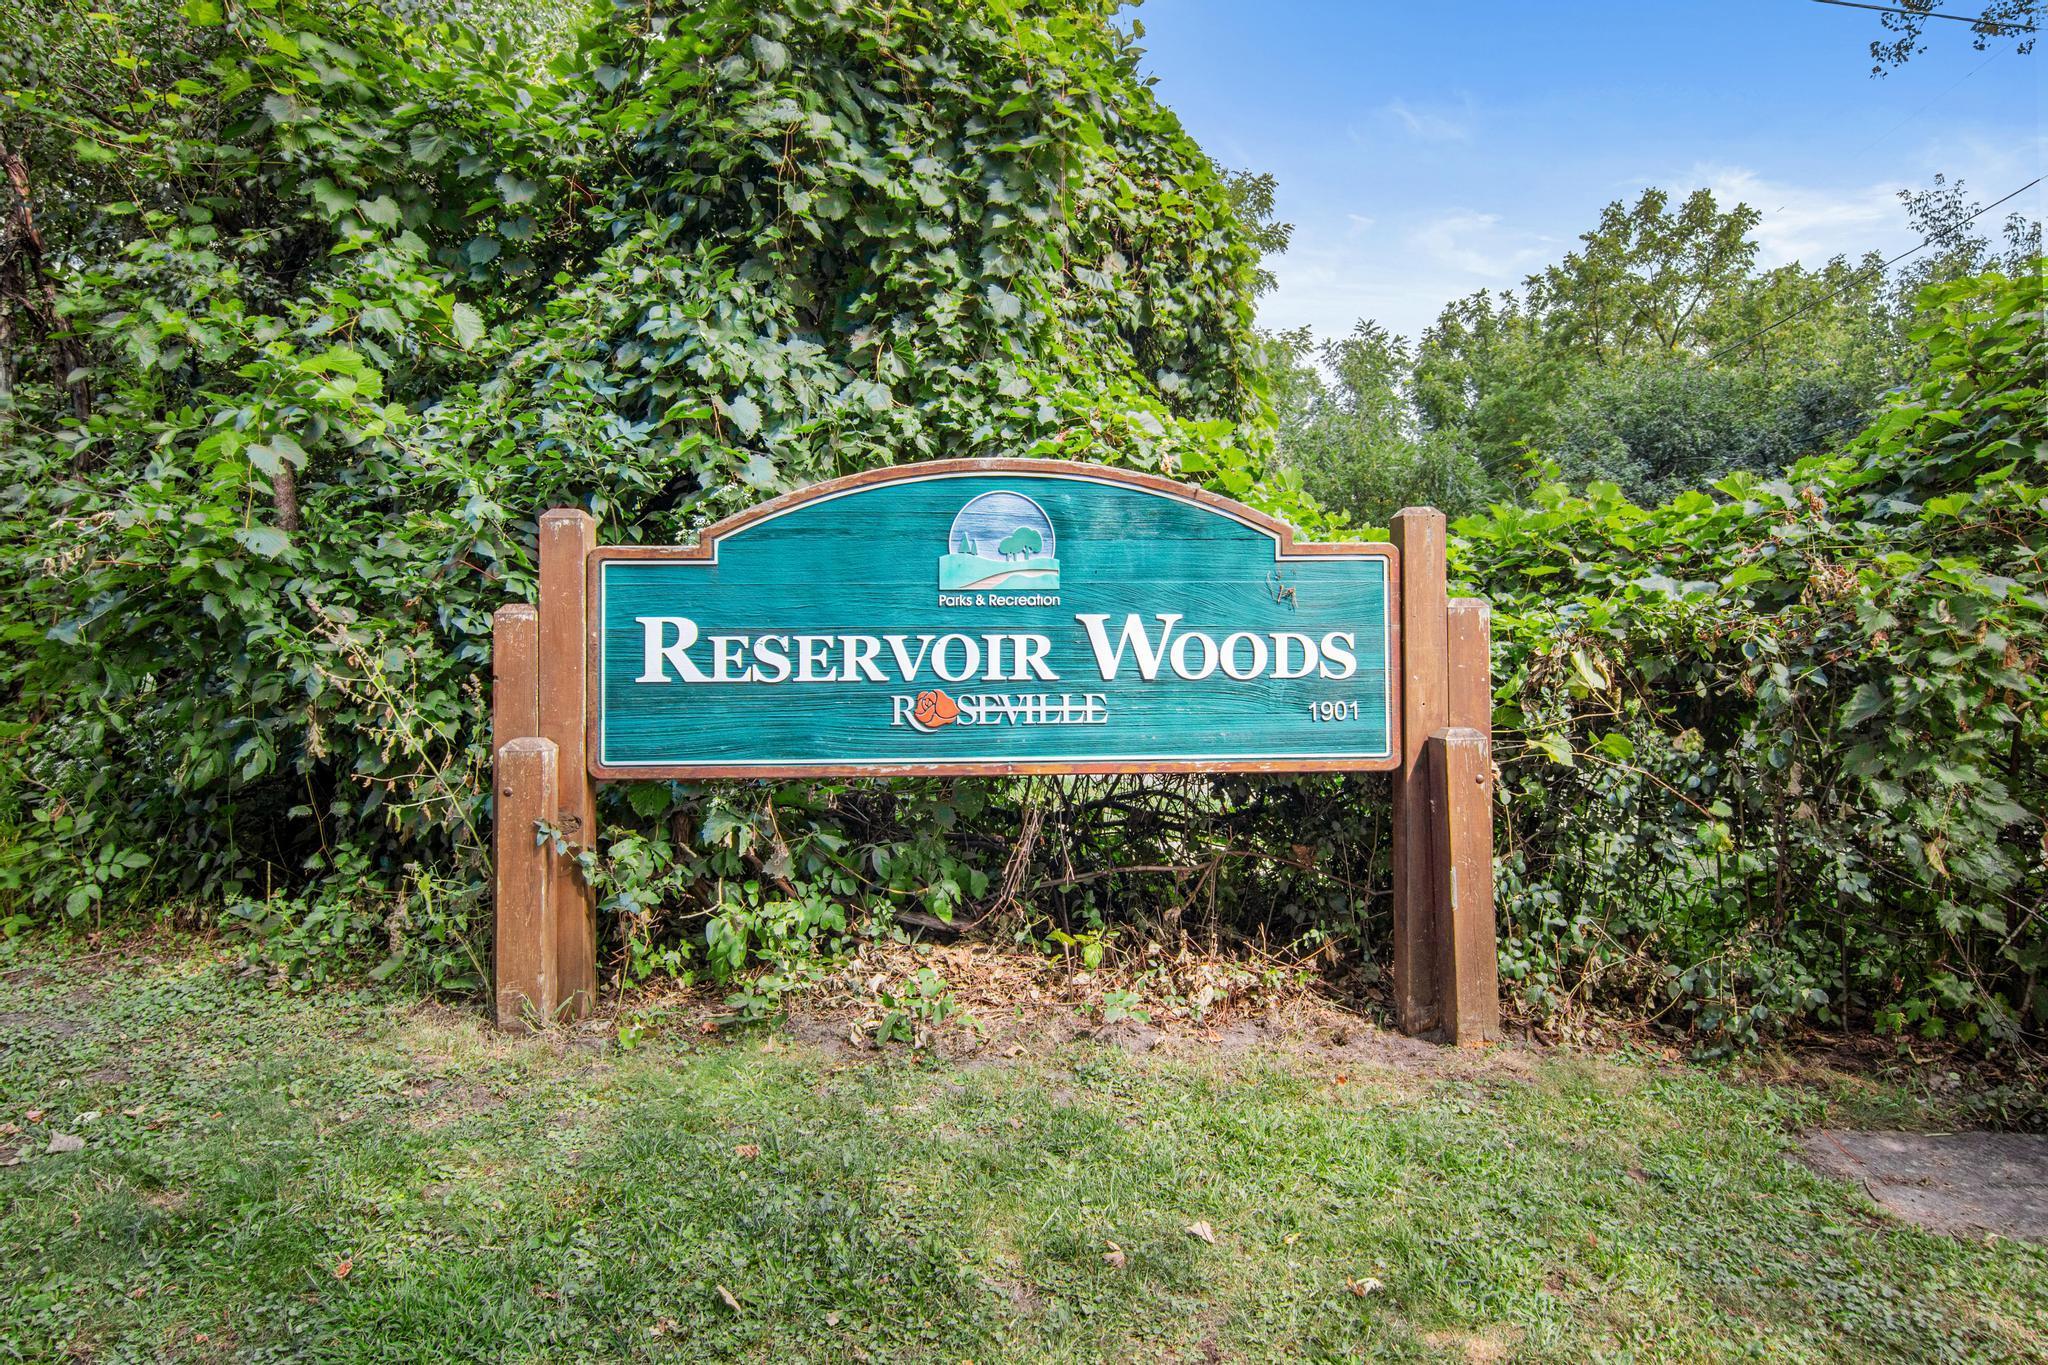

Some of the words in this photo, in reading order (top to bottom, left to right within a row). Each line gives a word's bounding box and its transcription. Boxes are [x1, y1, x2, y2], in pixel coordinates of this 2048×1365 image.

[938, 594, 972, 607] Parks
[975, 594, 986, 606] &
[988, 594, 1061, 607] Recreation
[635, 614, 1060, 683] RESERVOIR
[1075, 612, 1357, 681] WOODS
[1308, 700, 1359, 722] 1901
